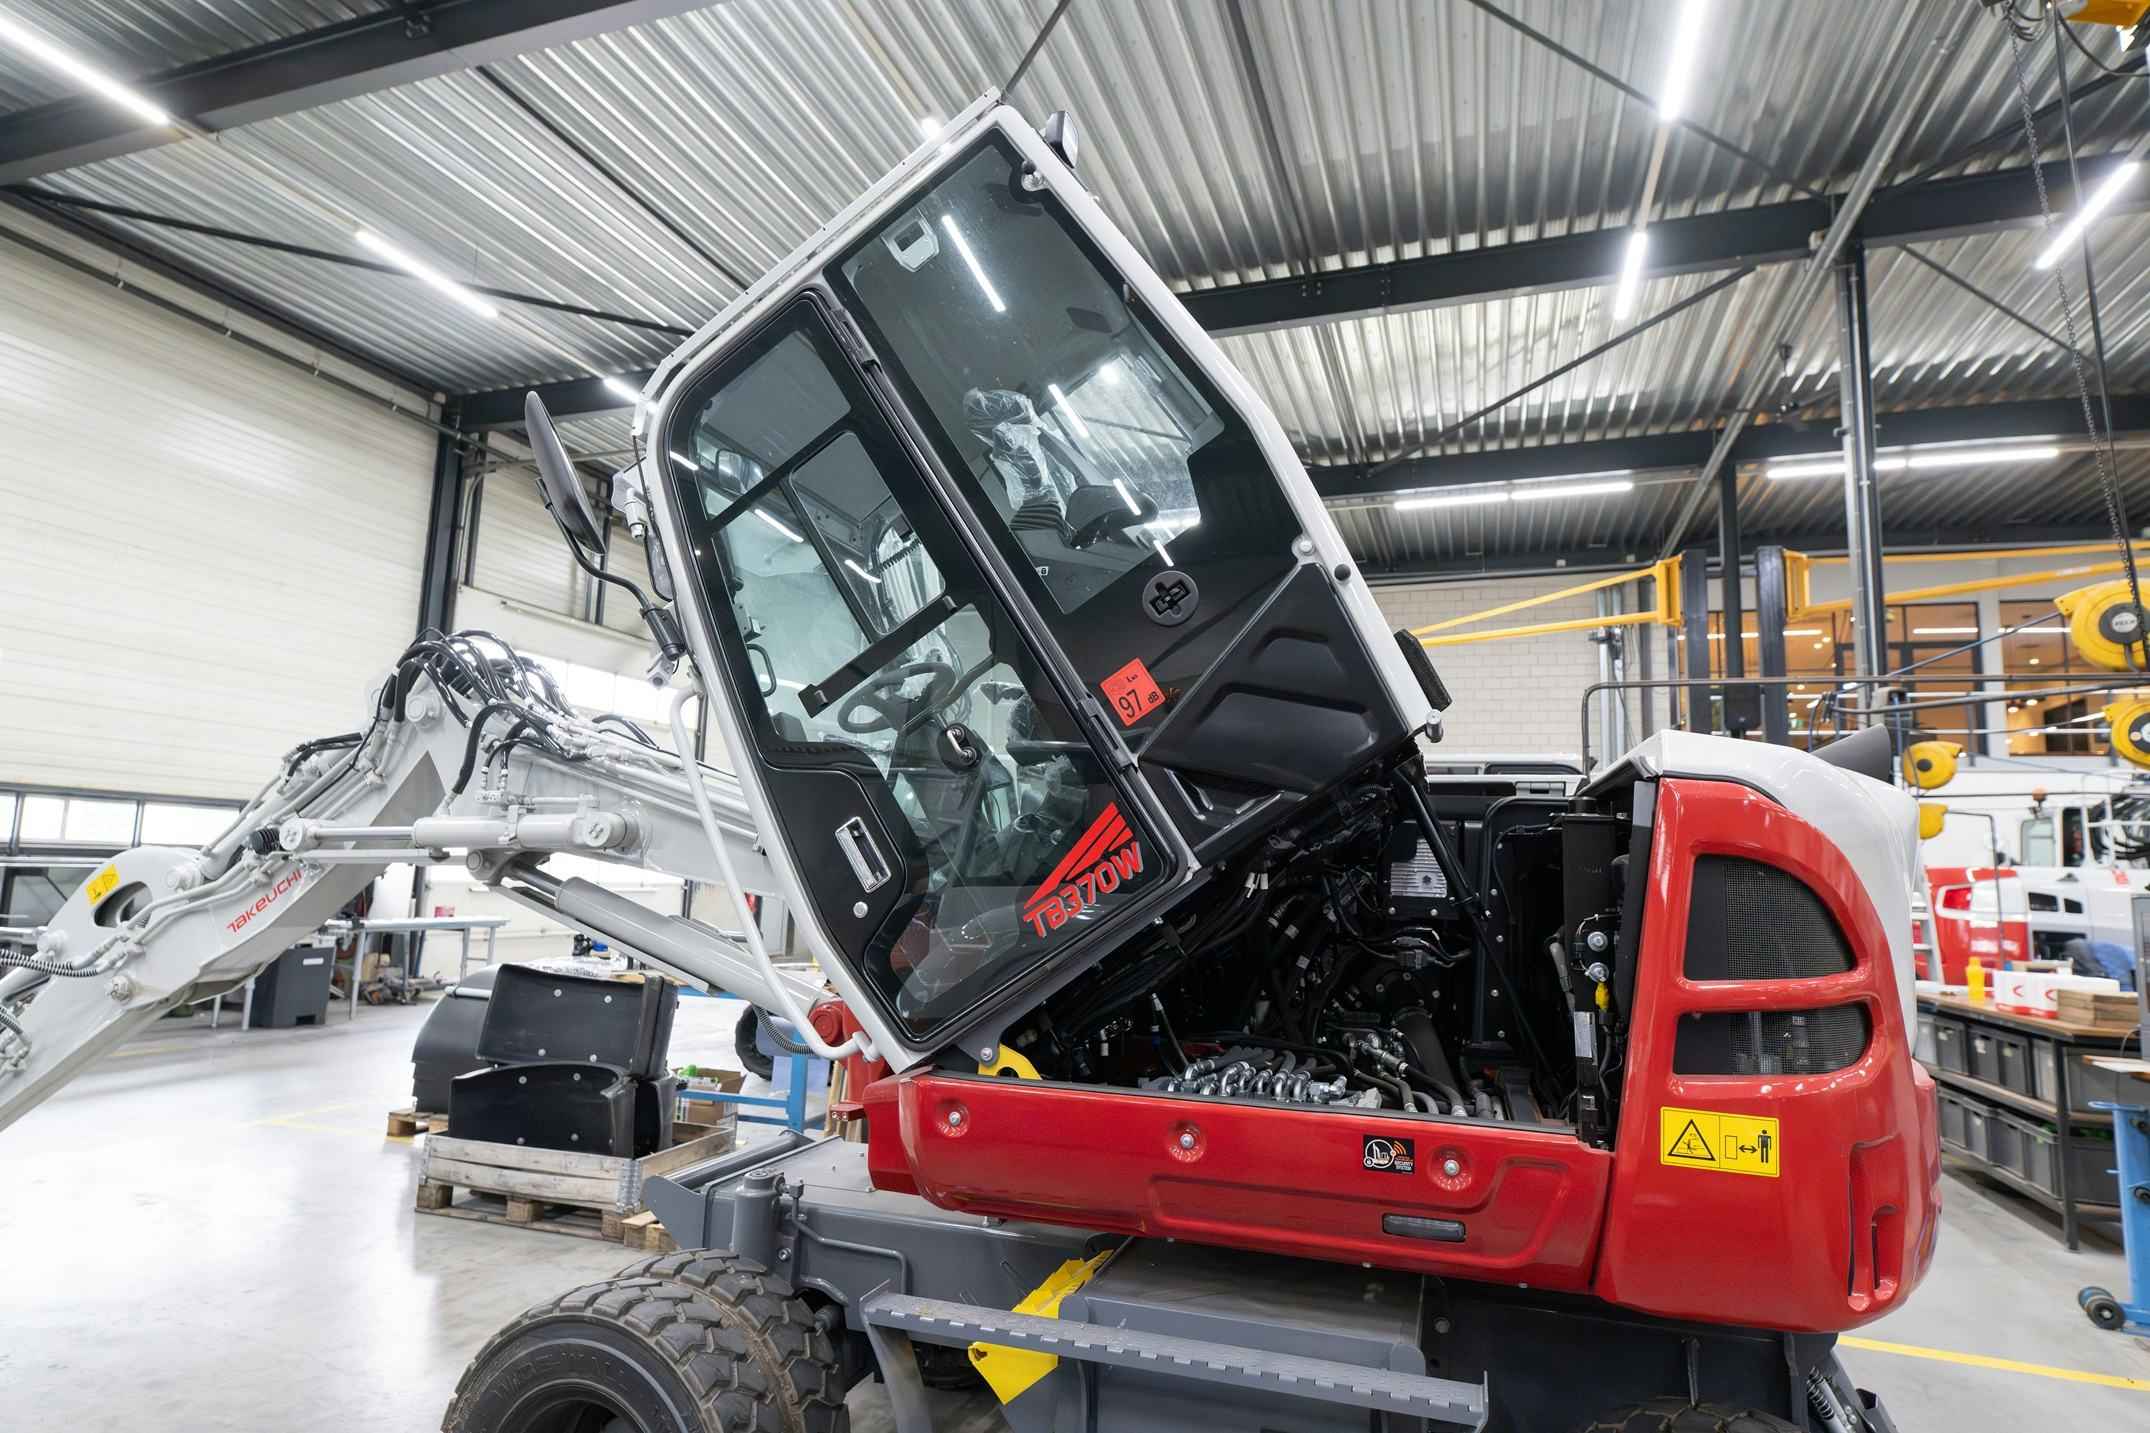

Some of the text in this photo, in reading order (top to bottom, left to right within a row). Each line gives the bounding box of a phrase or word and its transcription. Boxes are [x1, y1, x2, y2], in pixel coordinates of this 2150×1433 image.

[1118, 688, 1160, 719] 97 dB
[1022, 840, 1144, 939] TB370W
